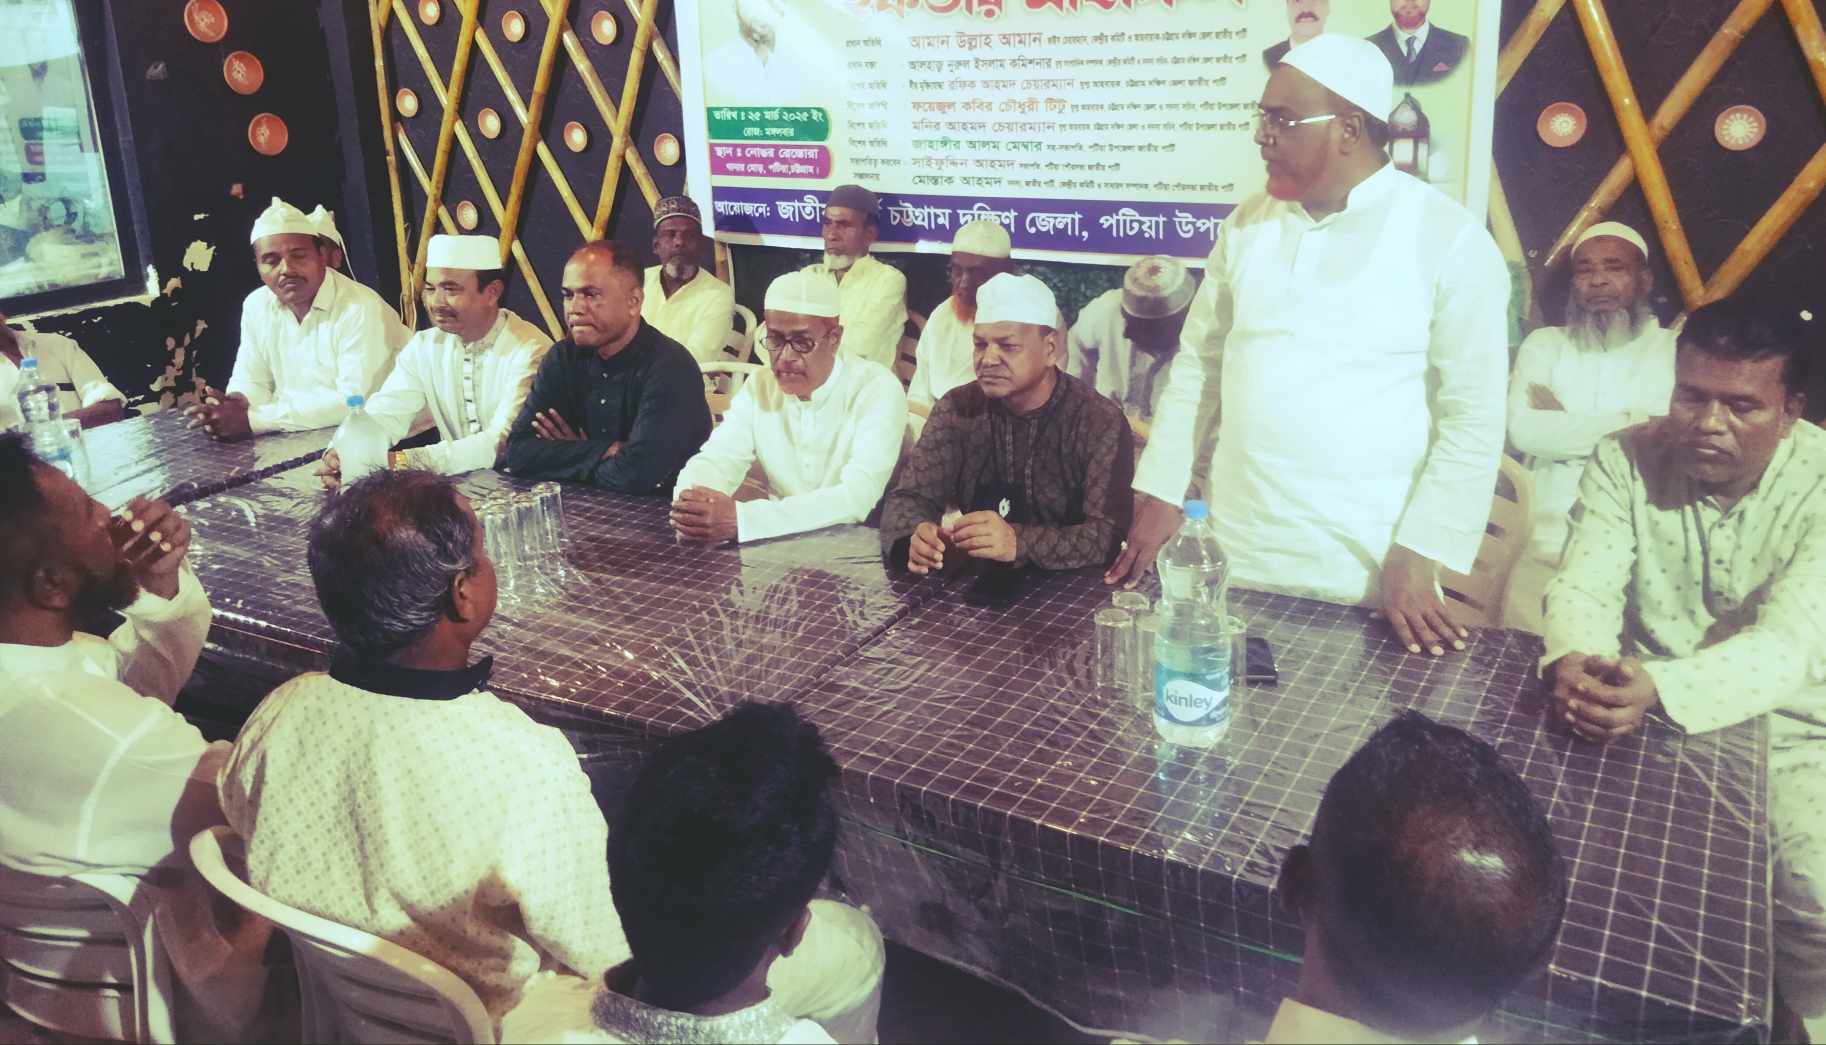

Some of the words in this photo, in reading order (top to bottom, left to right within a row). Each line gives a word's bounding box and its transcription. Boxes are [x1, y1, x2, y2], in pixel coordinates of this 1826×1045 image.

[911, 35, 950, 48] আমান
[955, 31, 993, 50] উল্লাহ
[998, 32, 1042, 48] আমান
[973, 57, 1006, 69] ইসলাম
[1009, 55, 1052, 69] কমিশনার
[960, 99, 992, 112] কবির
[999, 97, 1039, 113] চৌধুরী
[1044, 97, 1068, 114] টিটু
[712, 108, 738, 121] তারিখ
[748, 111, 761, 121] ২৫
[763, 108, 781, 121] মার্চ
[782, 111, 809, 122] ২০২৫
[945, 121, 987, 131] আহমদ
[991, 121, 1056, 132] চেয়ারম্যান
[714, 146, 733, 158] স্থান
[966, 140, 1000, 150] আলম
[1006, 141, 1042, 151] মেম্বার
[976, 159, 1016, 169] আহমদ
[960, 176, 1002, 187] আহমদ
[776, 195, 828, 223] জাতী
[888, 201, 951, 231] চট্টগ্রাম
[1026, 210, 1089, 241] জেলা,
[1099, 208, 1167, 239] পটিয়া
[1166, 688, 1214, 710] kinley
